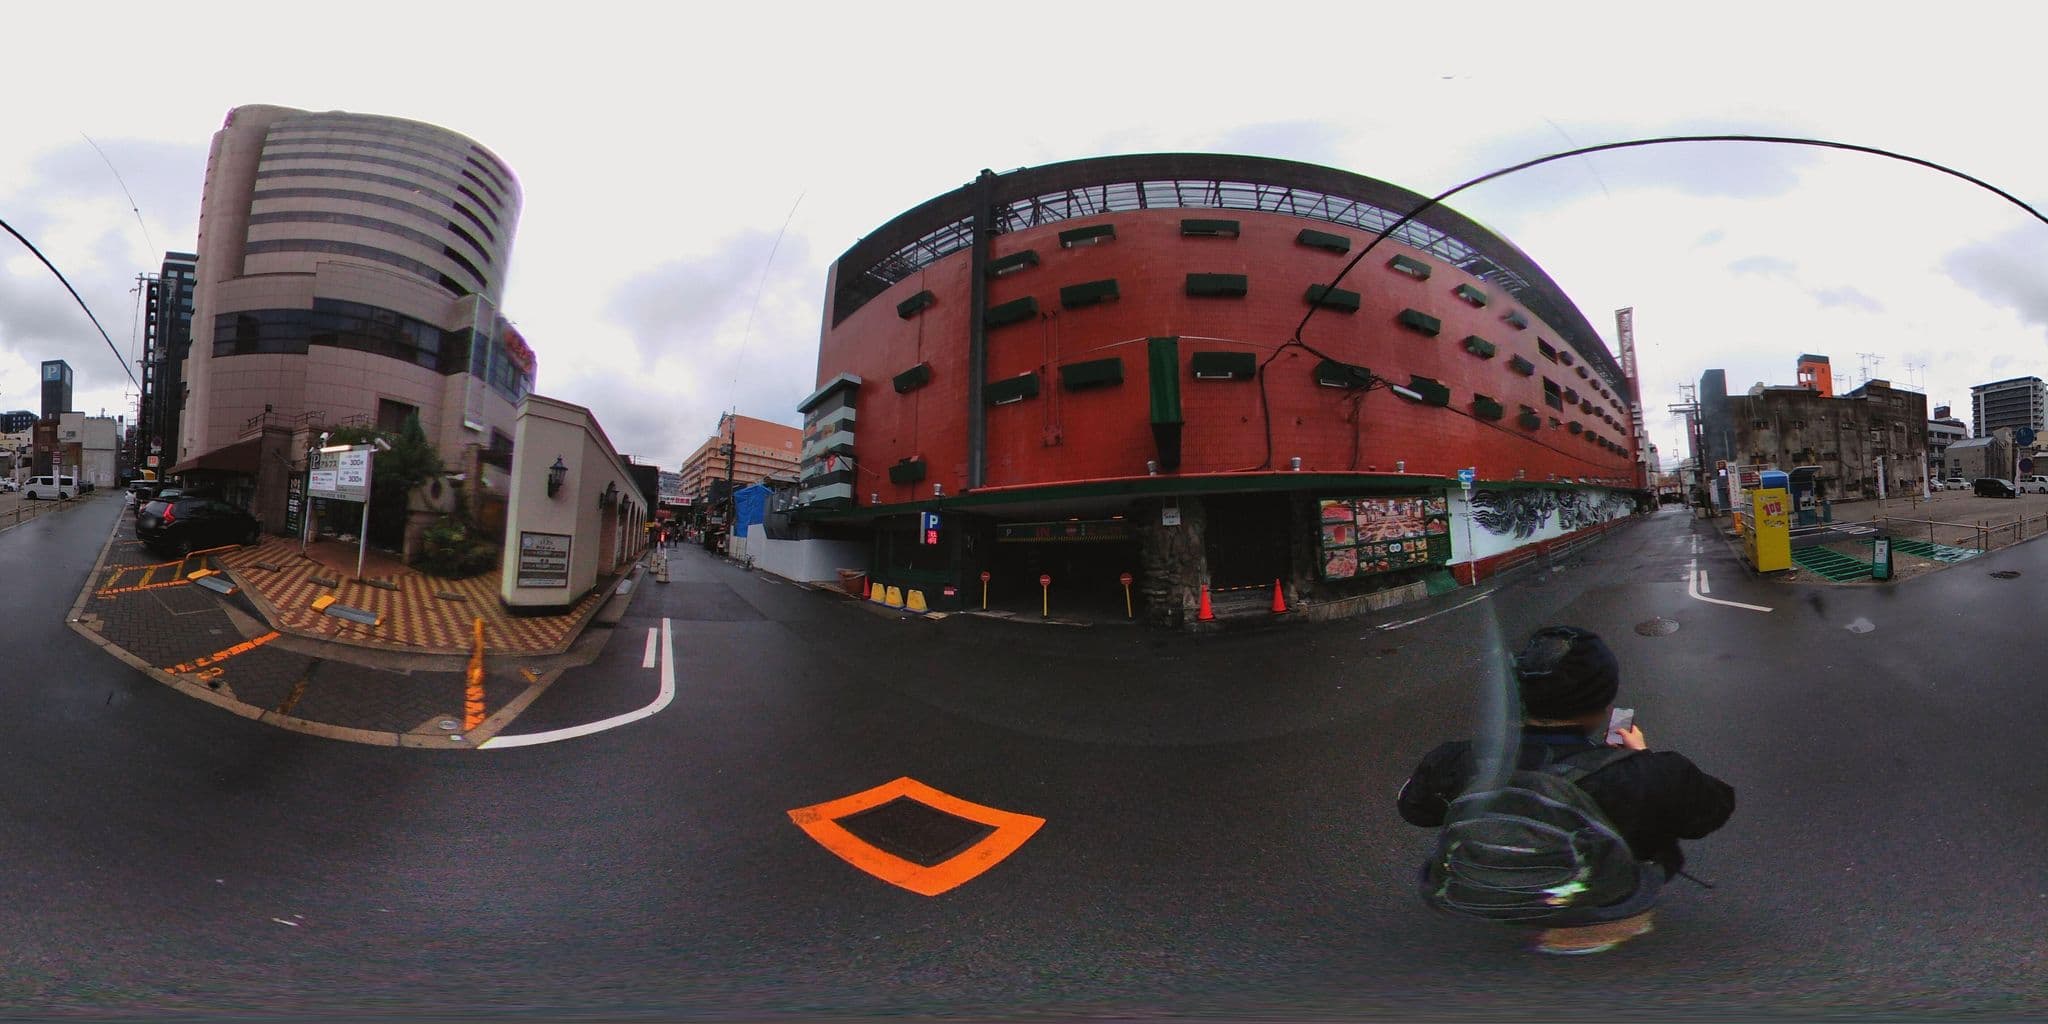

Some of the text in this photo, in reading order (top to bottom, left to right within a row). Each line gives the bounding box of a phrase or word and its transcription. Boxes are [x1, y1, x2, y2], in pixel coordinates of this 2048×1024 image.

[47, 366, 57, 379] P
[312, 454, 320, 469] P
[930, 514, 938, 529] P
